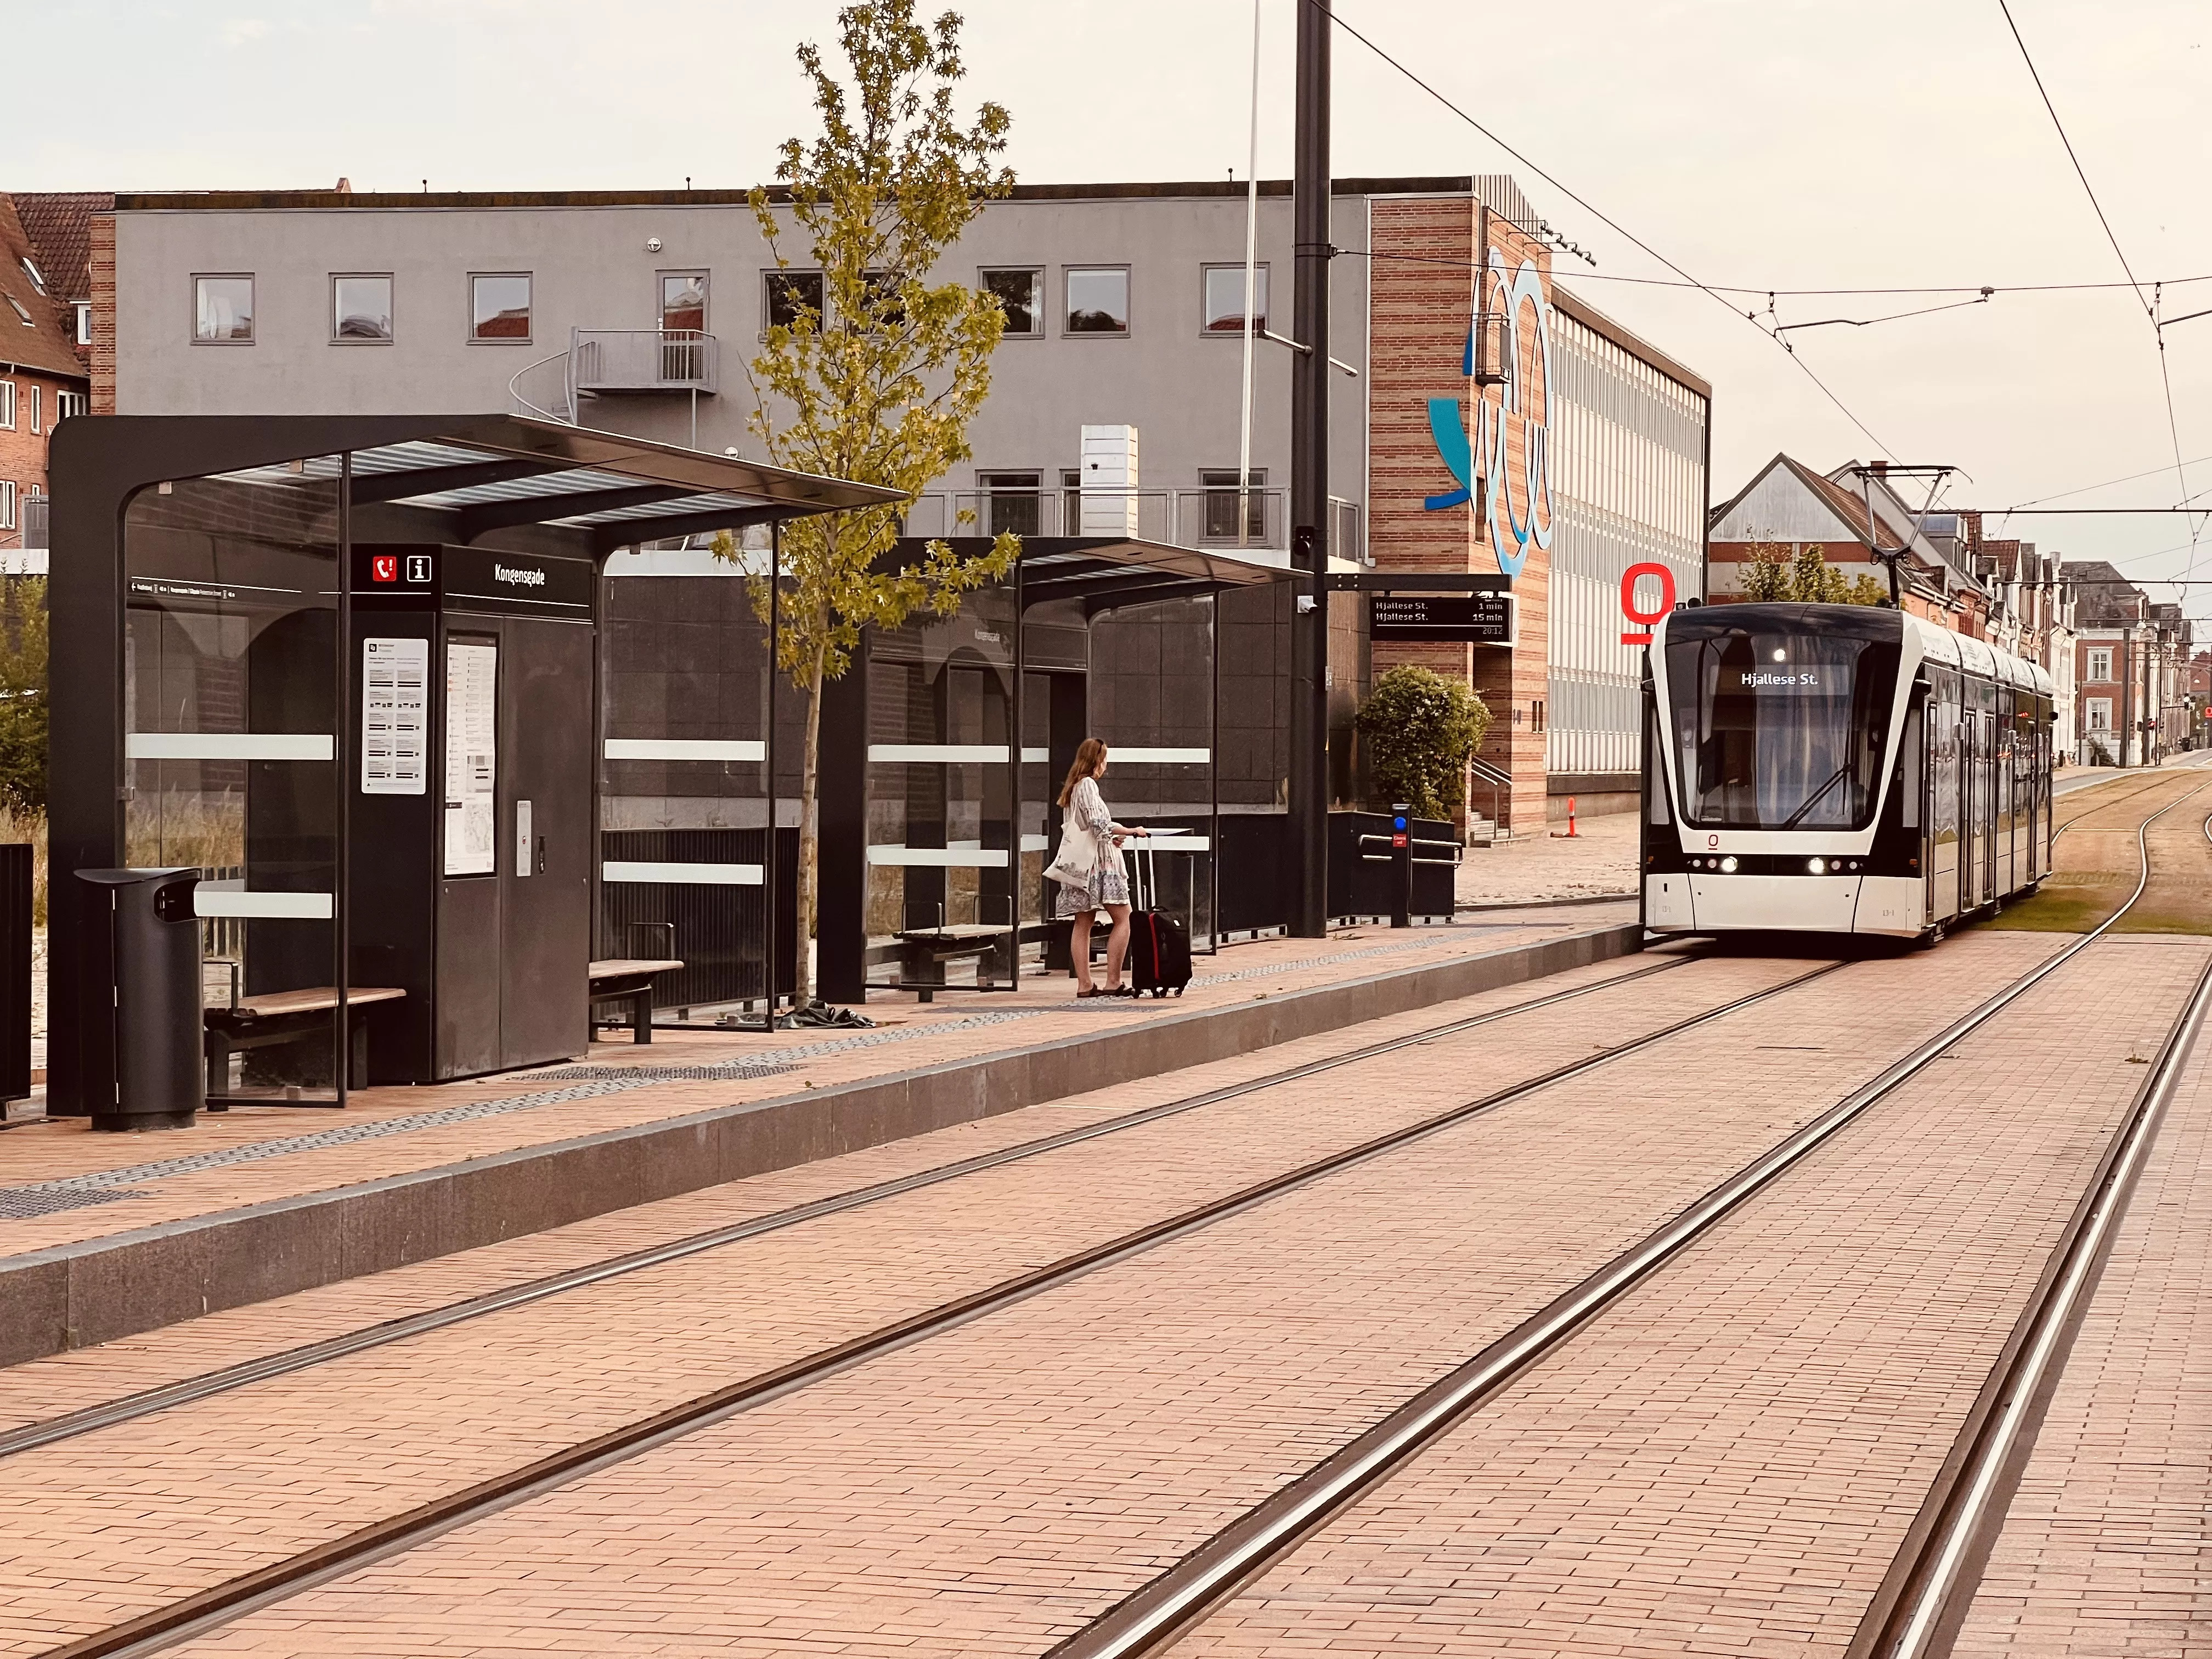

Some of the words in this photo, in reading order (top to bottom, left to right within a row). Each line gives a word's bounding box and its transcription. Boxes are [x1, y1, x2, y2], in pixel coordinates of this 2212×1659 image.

[495, 563, 545, 588] Kongensgade
[1376, 602, 1413, 611] Hjallese
[1376, 613, 1413, 621] Hjallese
[1741, 673, 1796, 688] Hjallese
[1800, 673, 1819, 685] St.
